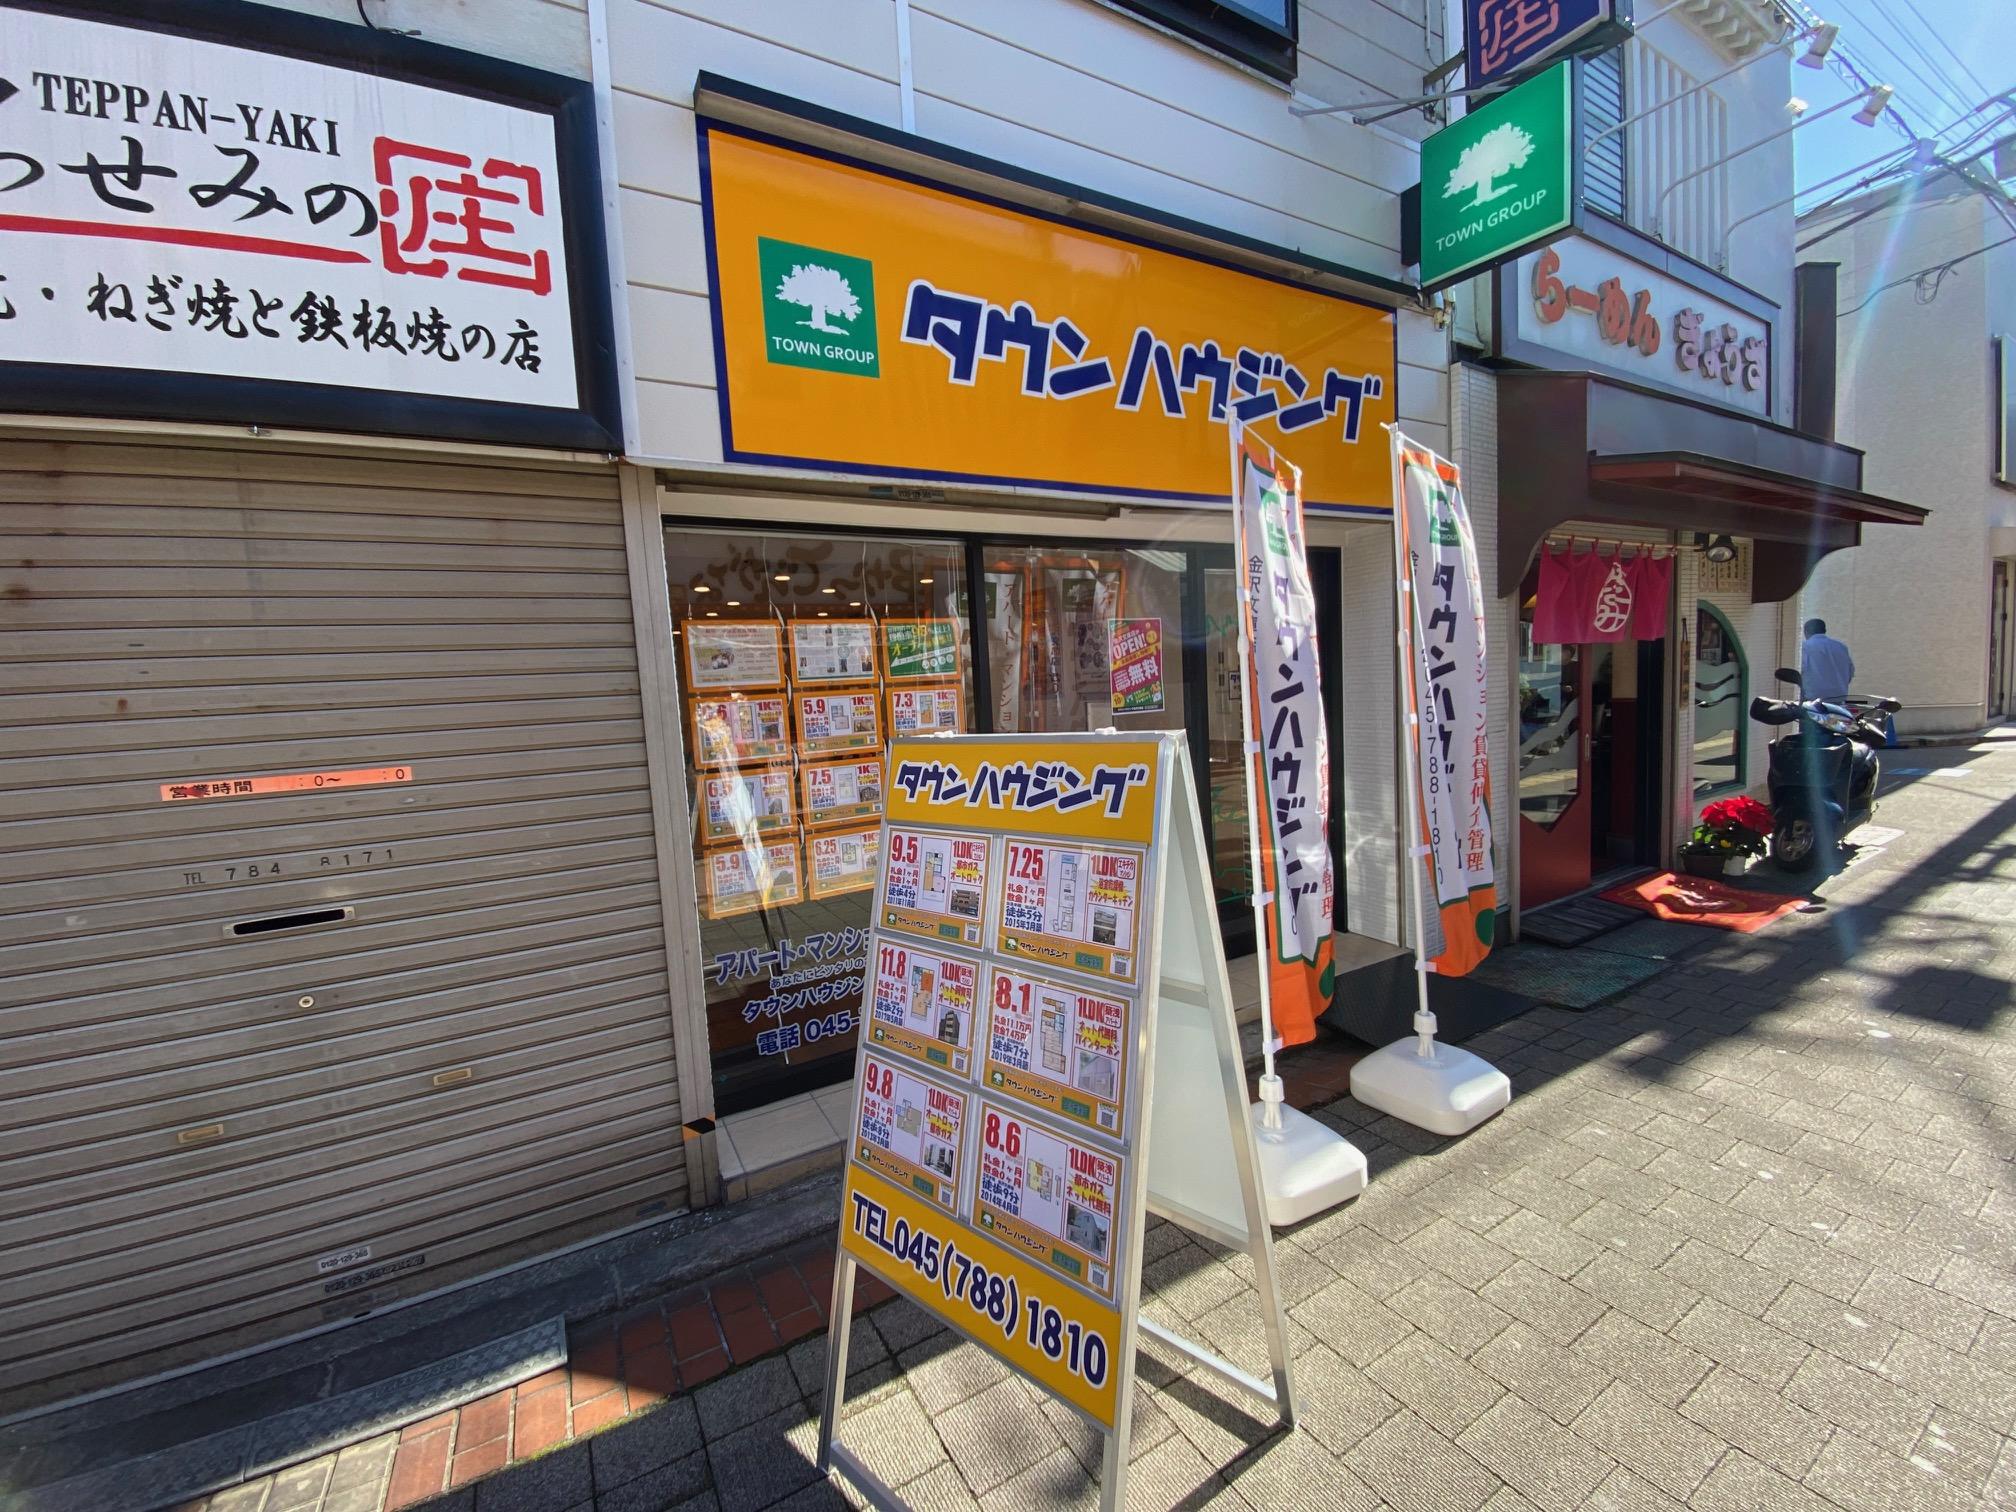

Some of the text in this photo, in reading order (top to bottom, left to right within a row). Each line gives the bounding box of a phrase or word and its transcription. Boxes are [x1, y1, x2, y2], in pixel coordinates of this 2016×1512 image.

[32, 71, 342, 157] TEPPAN-YAKI
[1436, 189, 1547, 251] TOWN GROUP
[1532, 250, 1766, 391] らーめん ぎょうざ
[772, 336, 875, 364] TOWN GROUP
[902, 280, 1382, 442] タウンハウジング
[1113, 632, 1148, 660] OPEN!
[1128, 656, 1159, 686] 無料
[803, 698, 826, 715] 5.9
[893, 693, 913, 708] 7.3
[169, 779, 253, 799] 営業時間
[808, 768, 832, 786] 7.5
[895, 762, 1147, 816] タウンハウジング
[814, 839, 837, 856] 6.25
[891, 835, 972, 863] 9.5 1LDK
[1010, 845, 1118, 880] 7.25 1LDK
[715, 854, 740, 872] 5.9
[1006, 906, 1043, 922] 徒歩5分
[770, 956, 868, 991] あなたにピッタリの
[881, 947, 960, 983] 11.8 1LDK
[995, 976, 1105, 1024] 8.1 1LDK
[757, 1010, 862, 1056] 電話 045-
[992, 1038, 1030, 1060] 徒歩7分
[866, 1062, 949, 1114] 9.8 1LDK
[985, 1113, 1097, 1177] 8.6 1LDK
[982, 1176, 1020, 1205] 徒歩9分
